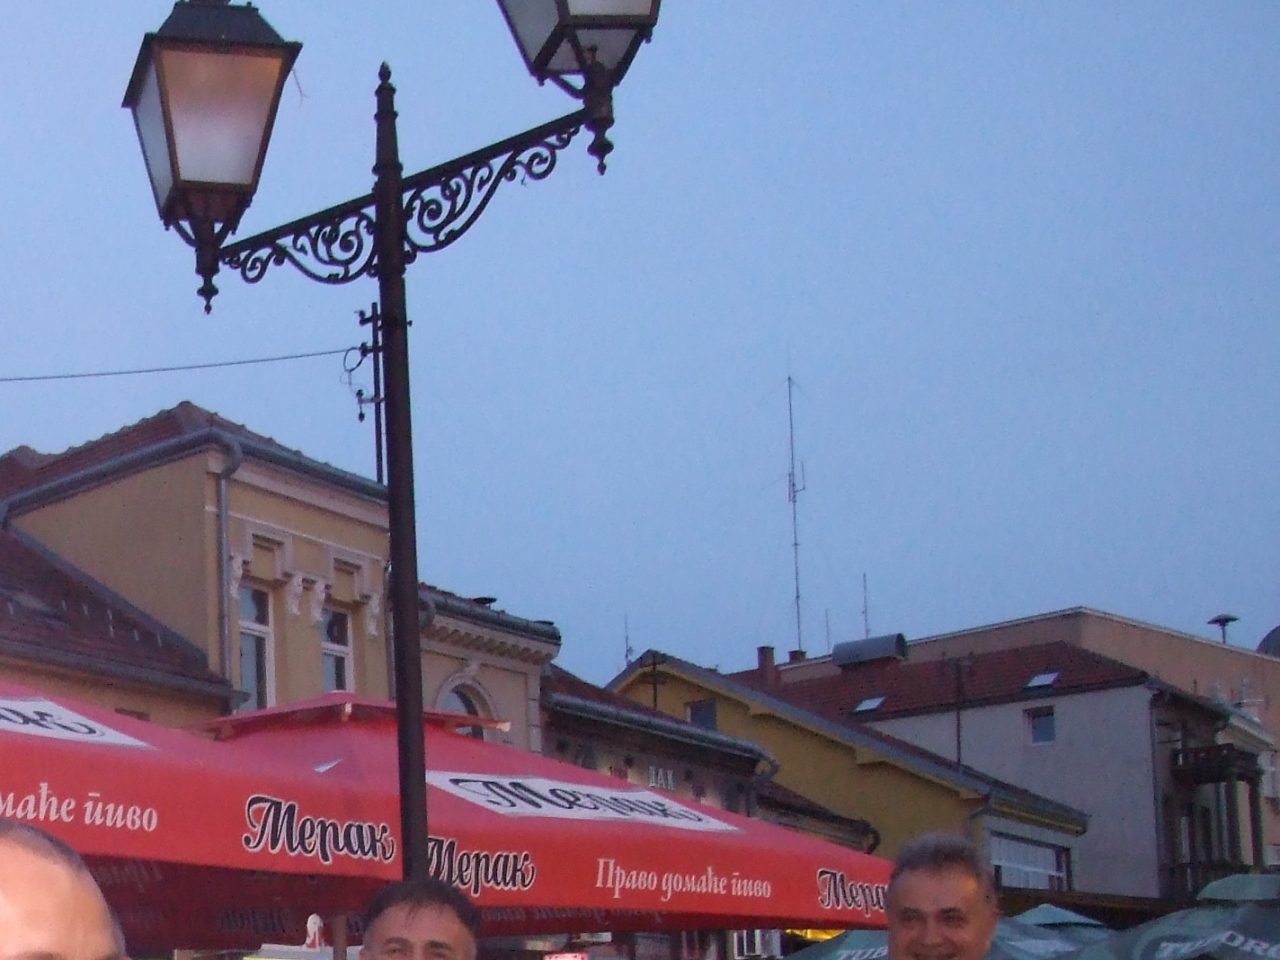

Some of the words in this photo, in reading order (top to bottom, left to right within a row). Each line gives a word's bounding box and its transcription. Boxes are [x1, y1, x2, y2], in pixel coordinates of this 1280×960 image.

[242, 794, 397, 865] Мерак
[426, 836, 536, 897] Мерак
[596, 858, 657, 899] Право
[661, 866, 727, 901] домаће
